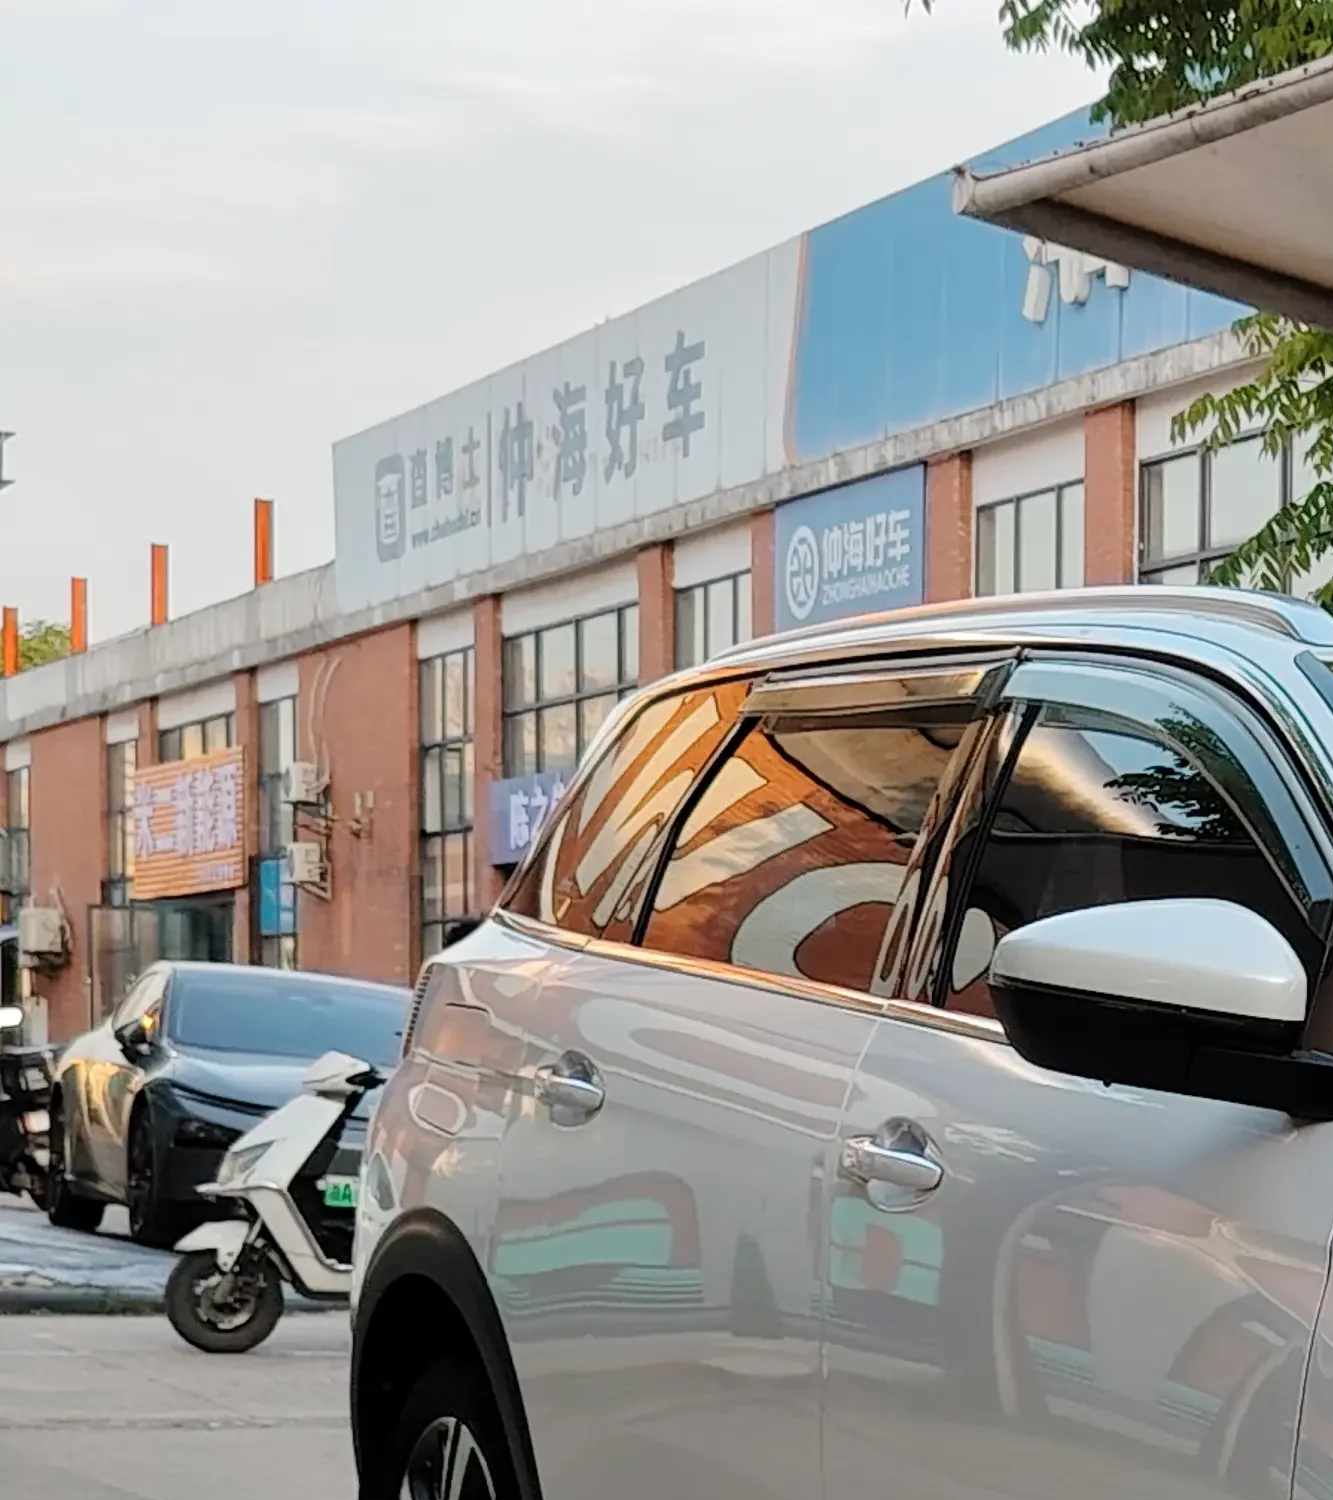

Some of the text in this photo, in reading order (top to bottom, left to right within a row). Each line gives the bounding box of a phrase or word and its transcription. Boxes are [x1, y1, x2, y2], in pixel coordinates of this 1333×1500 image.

[498, 329, 706, 524] 仲海好车
[822, 509, 911, 581] 仲海好车
